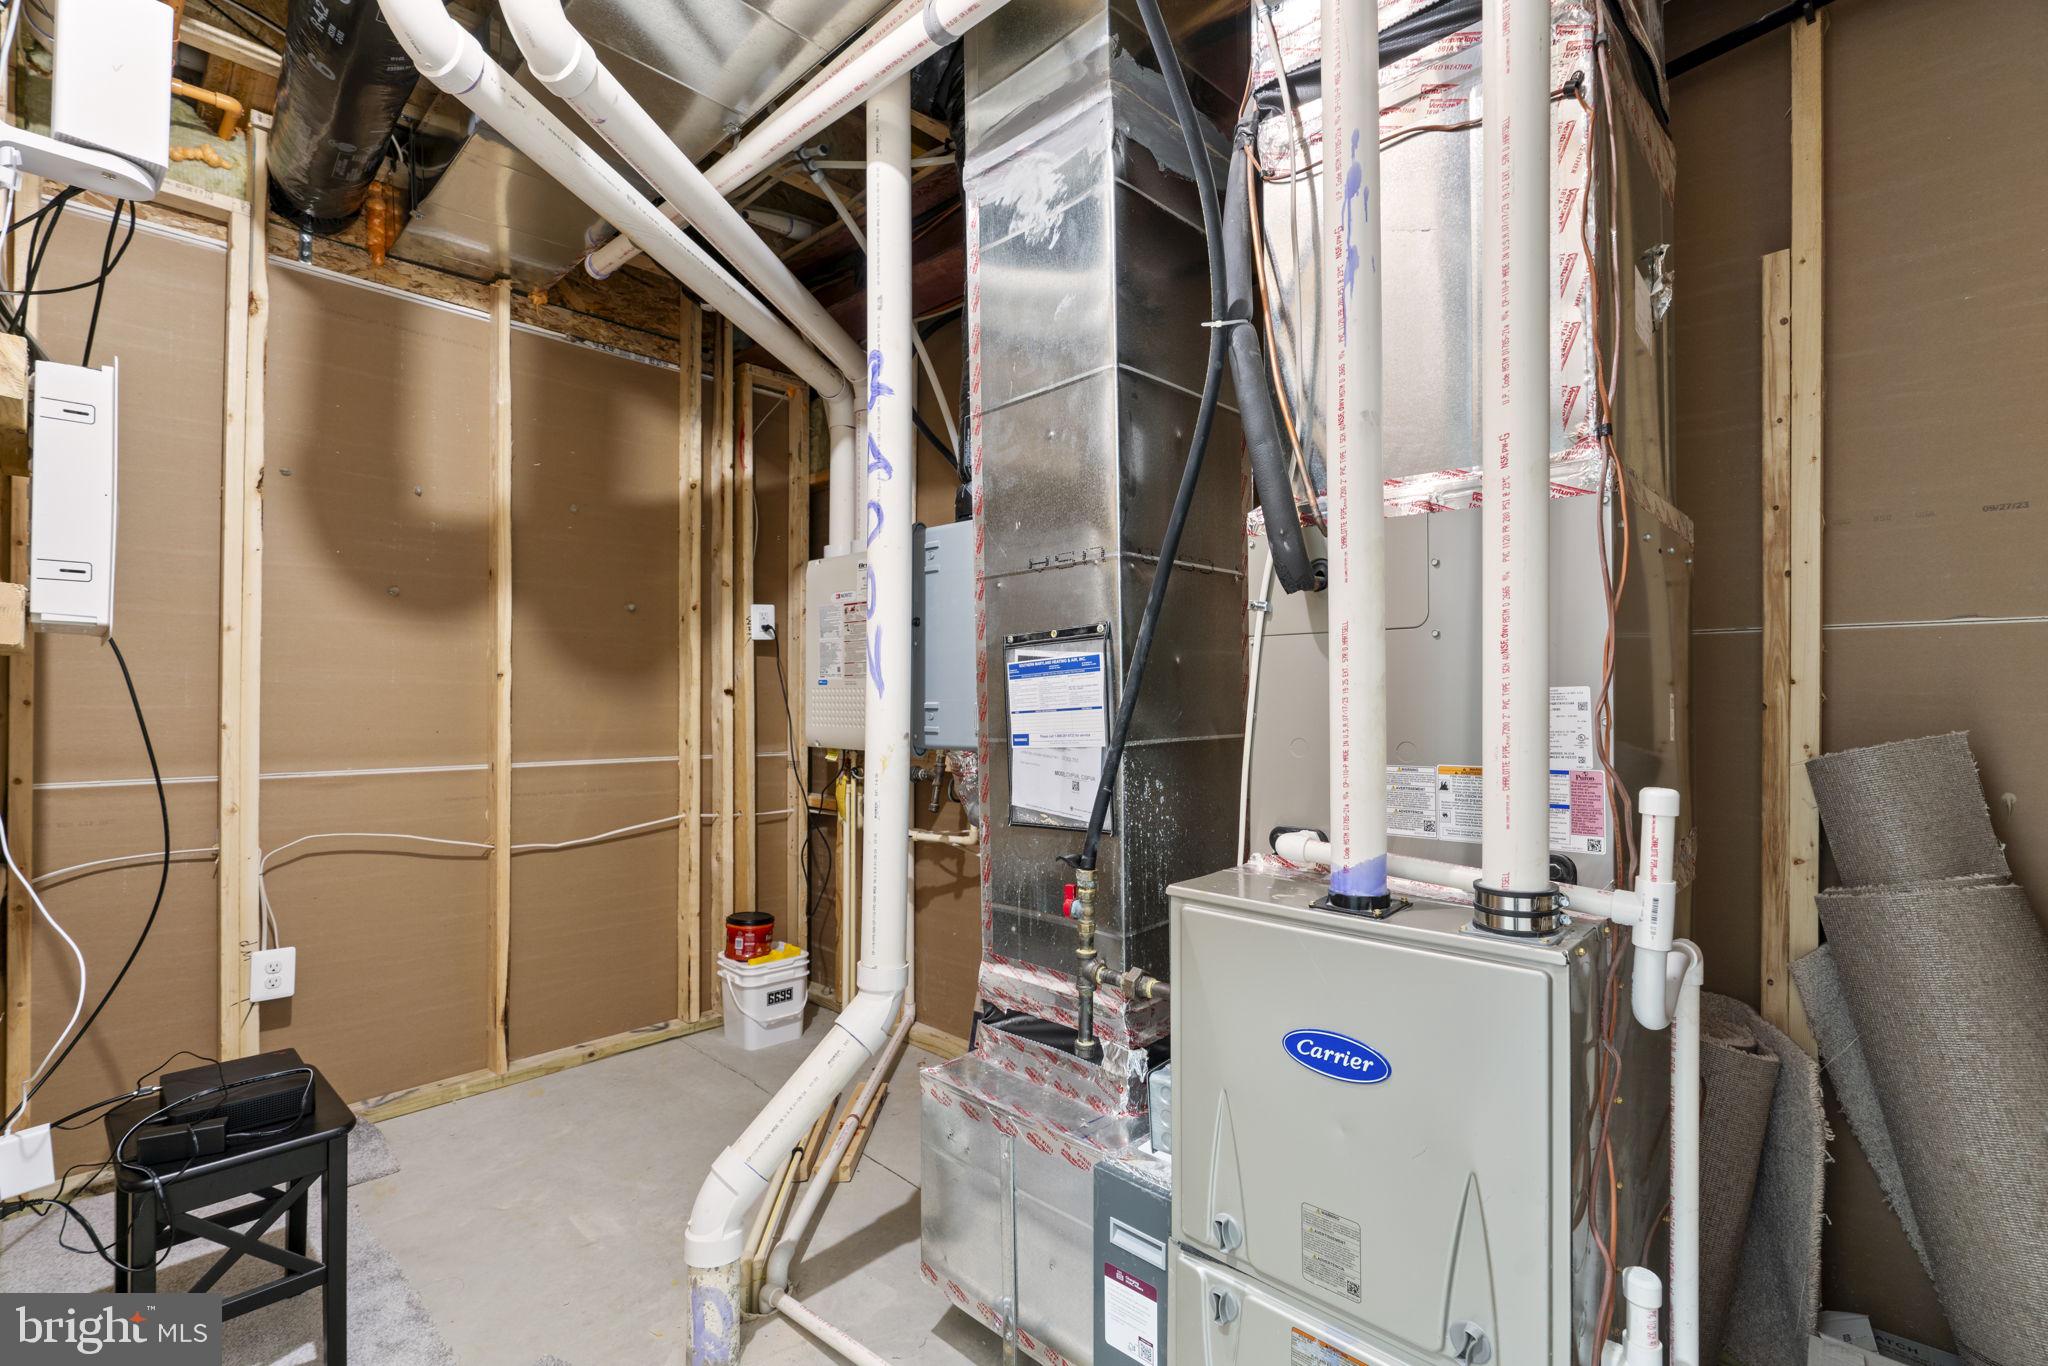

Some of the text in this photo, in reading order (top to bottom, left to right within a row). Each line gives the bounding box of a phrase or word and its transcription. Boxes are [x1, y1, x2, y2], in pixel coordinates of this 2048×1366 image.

[1502, 373, 1510, 388] Code
[1340, 521, 1348, 550] CHARLOTTE
[1502, 525, 1510, 534] PR
[1502, 535, 1511, 549] 1120
[1502, 551, 1510, 563] PVC
[1501, 662, 1510, 674] SCH
[1501, 682, 1510, 696] TYPE
[1501, 698, 1510, 710] PVC
[1502, 744, 1510, 759] PIPE
[1502, 760, 1510, 791] CHARLOTTE
[767, 988, 793, 1006] 6699
[1295, 1038, 1376, 1075] Carrier
